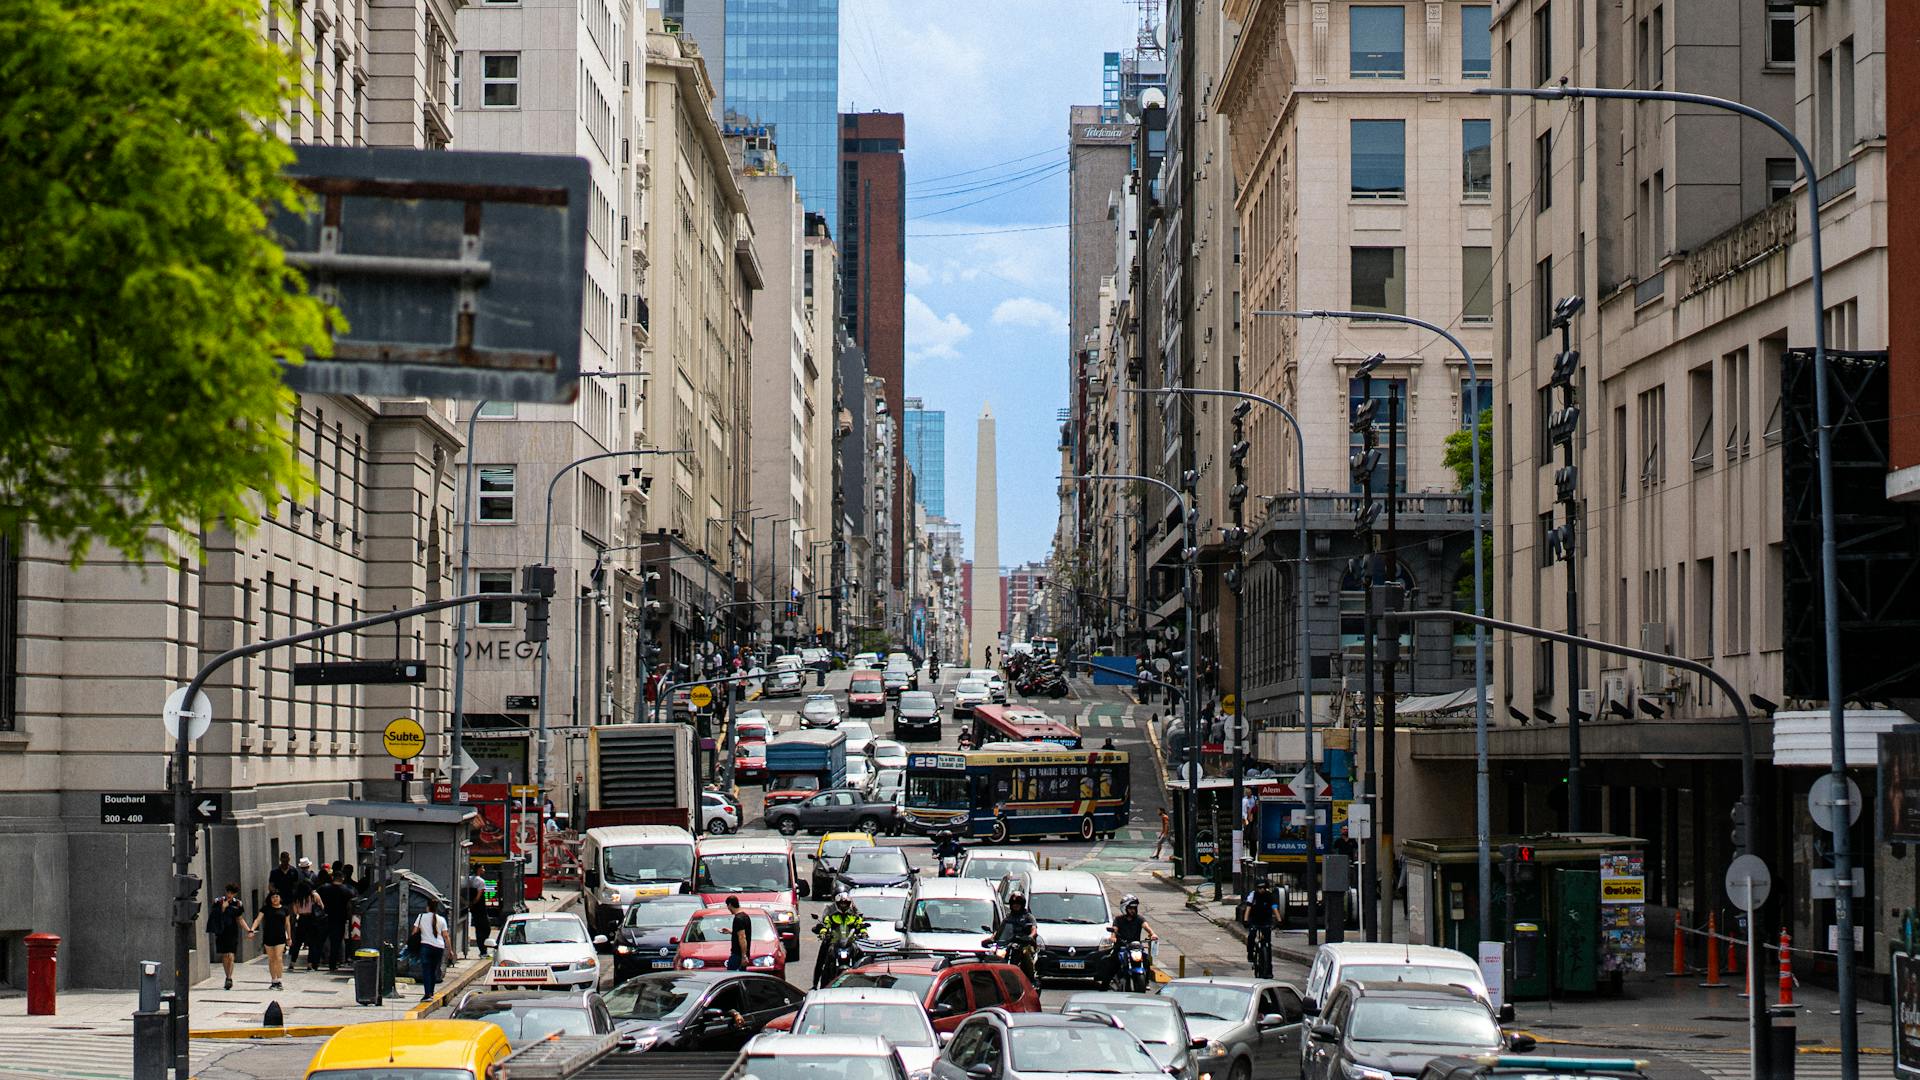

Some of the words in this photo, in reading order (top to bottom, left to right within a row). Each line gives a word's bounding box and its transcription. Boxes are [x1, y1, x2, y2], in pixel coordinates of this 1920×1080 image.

[453, 640, 550, 660] OMEGA
[389, 731, 419, 741] Subte
[914, 757, 937, 767] 29
[1262, 786, 1281, 794] Alem
[105, 795, 145, 803] Bouchard
[494, 969, 510, 977] TAXI
[511, 969, 547, 977] PREMIUM
